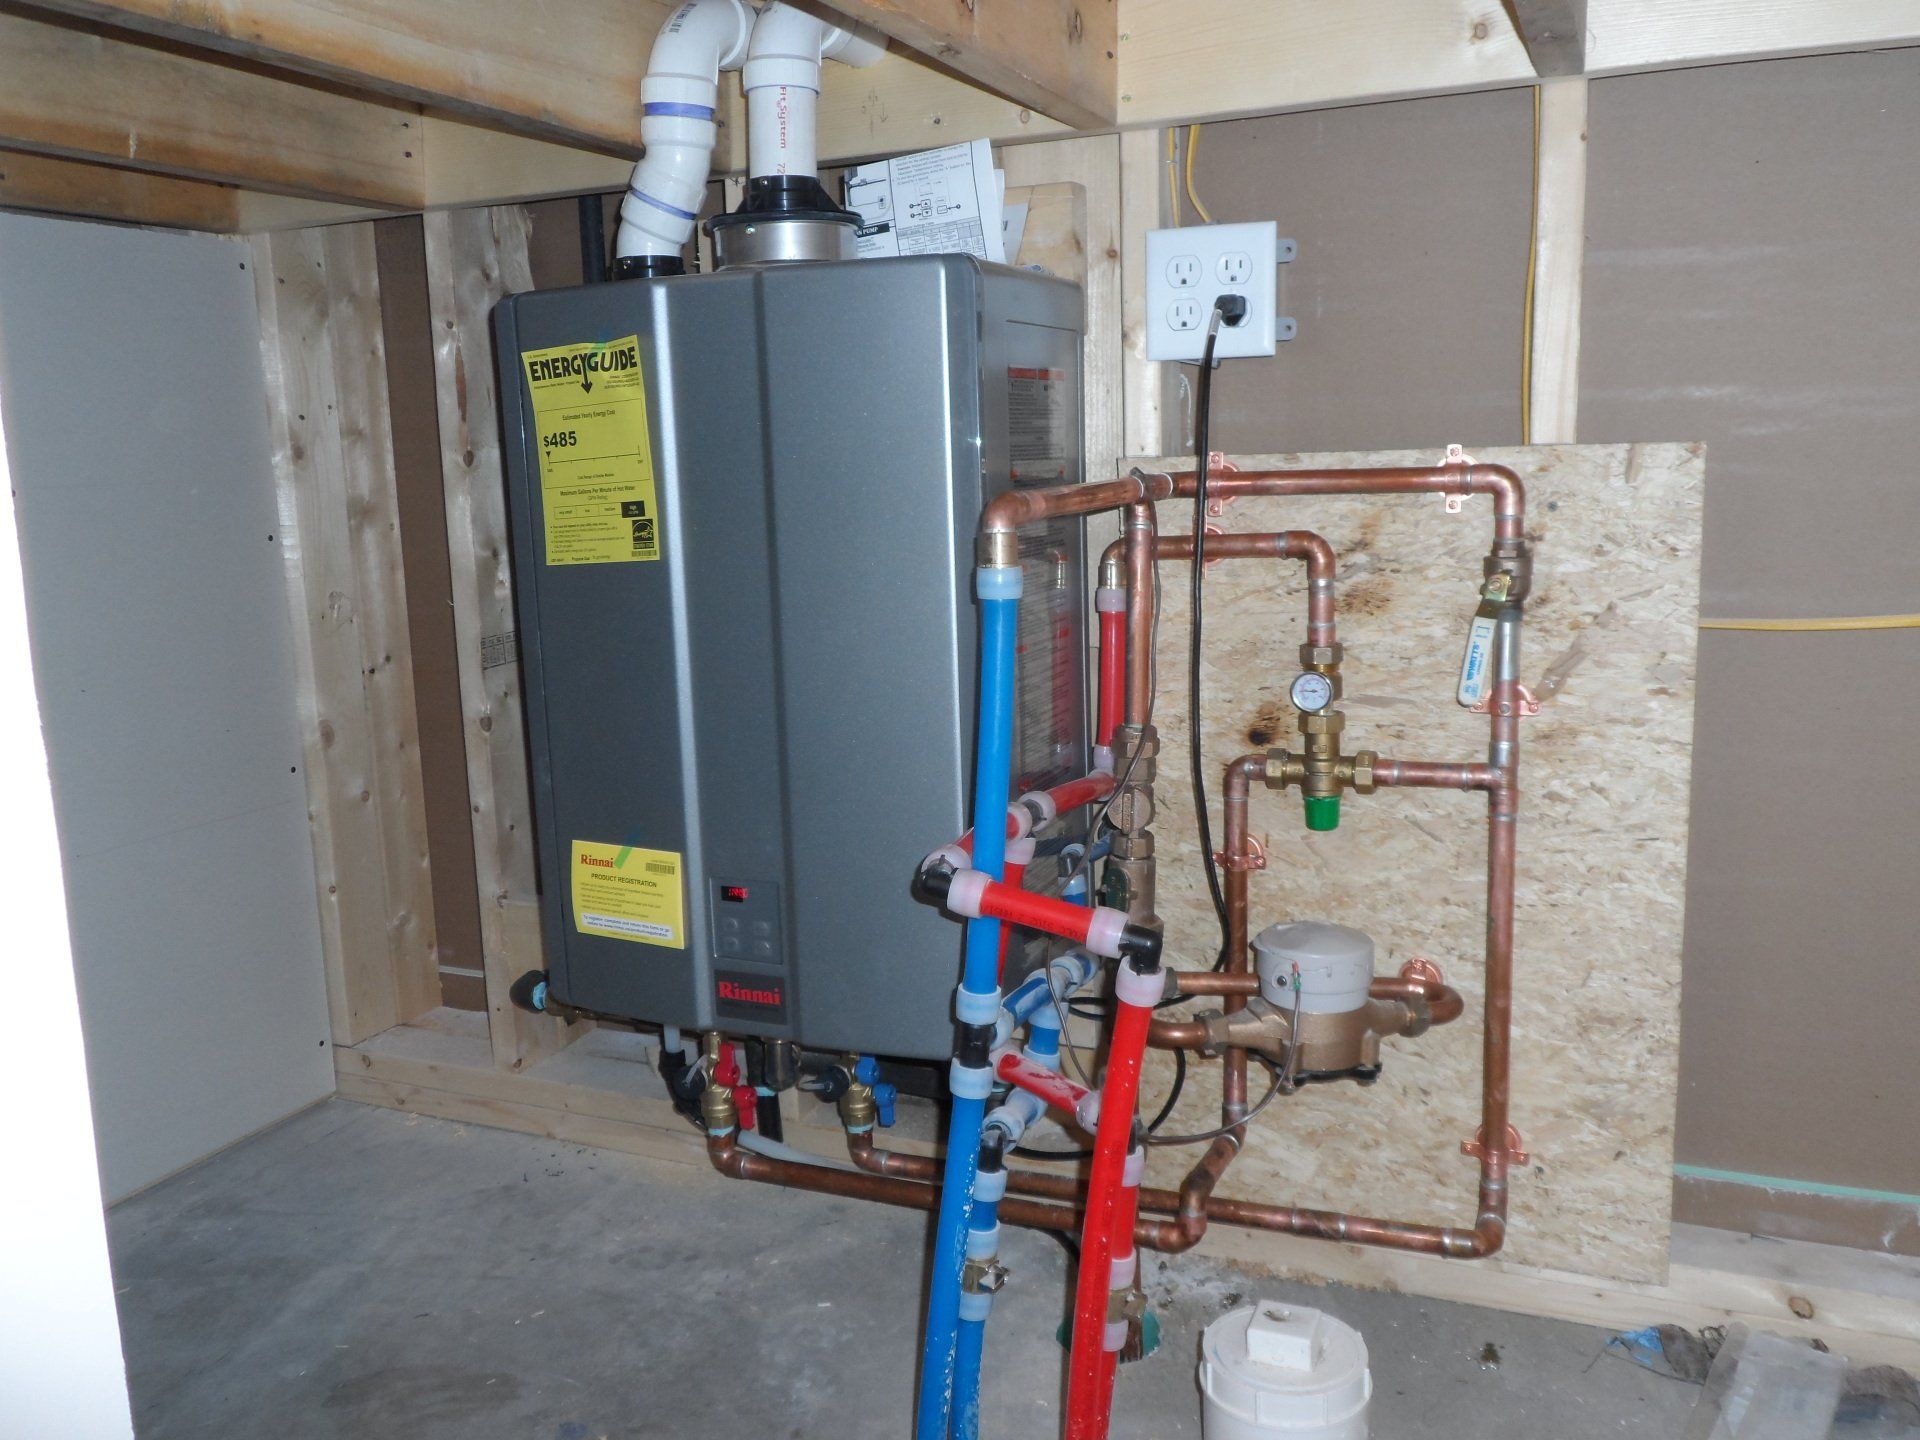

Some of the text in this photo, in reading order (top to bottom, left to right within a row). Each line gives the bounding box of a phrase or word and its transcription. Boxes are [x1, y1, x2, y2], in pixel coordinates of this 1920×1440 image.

[777, 105, 788, 149] System
[593, 410, 606, 418] Energy
[543, 431, 577, 448] $485
[580, 854, 614, 868] Rinnai
[590, 872, 658, 888] PRODUCT REGISTRATION
[718, 981, 782, 1005] Rinnai
